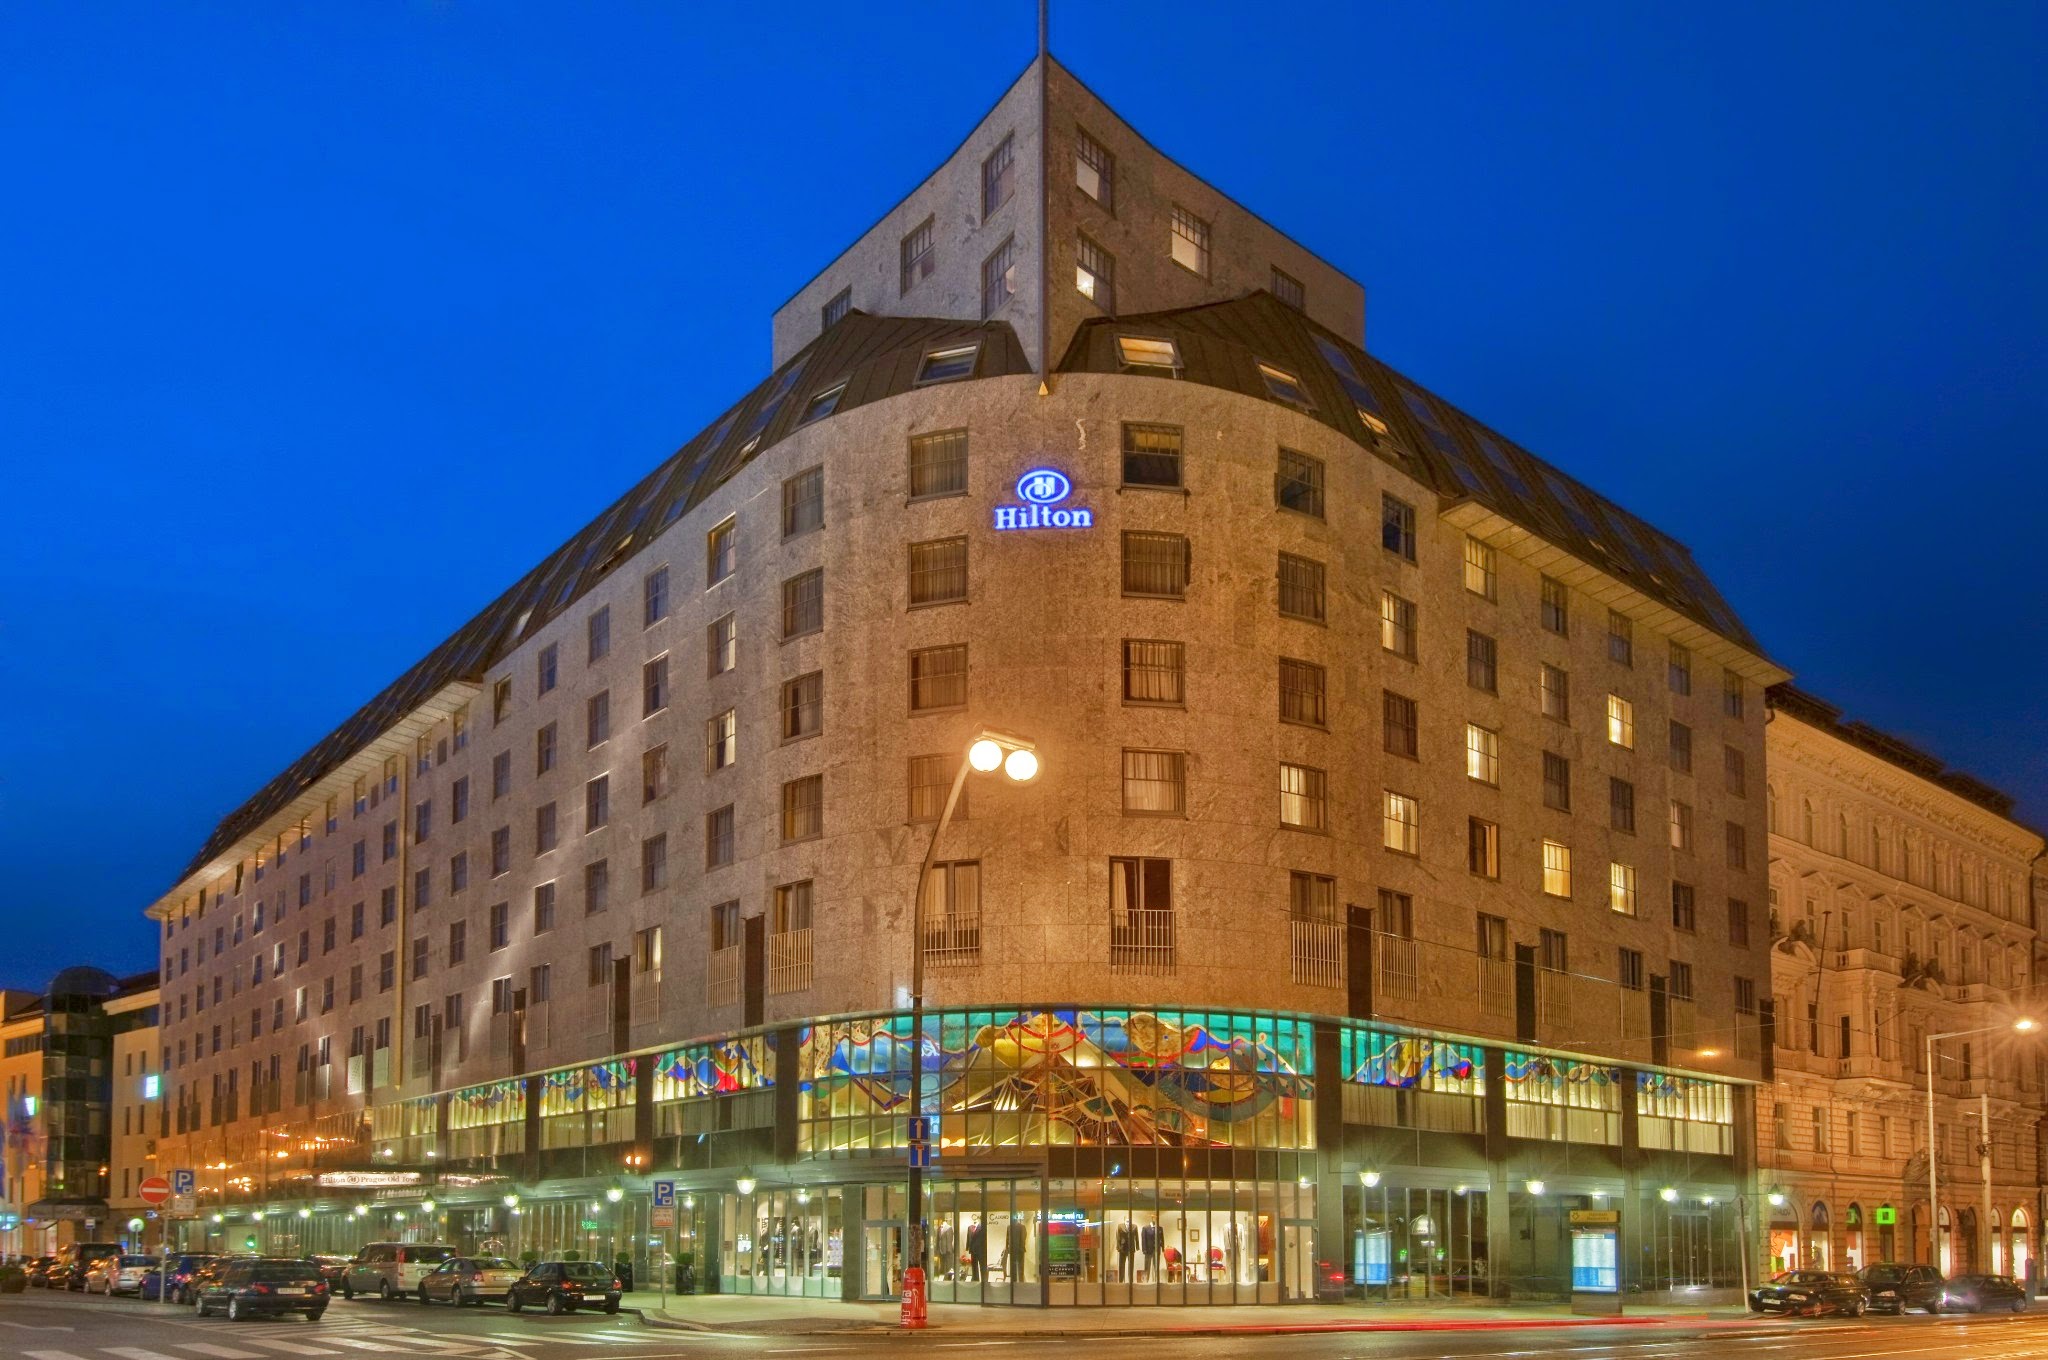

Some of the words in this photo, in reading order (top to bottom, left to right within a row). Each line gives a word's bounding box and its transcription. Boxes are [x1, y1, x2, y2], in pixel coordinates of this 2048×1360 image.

[994, 504, 1092, 530] Hilton
[322, 1176, 345, 1184] Hilton
[361, 1176, 386, 1184] Prague
[387, 1174, 400, 1183] Old
[402, 1175, 421, 1183] Town
[657, 1183, 670, 1199] P
